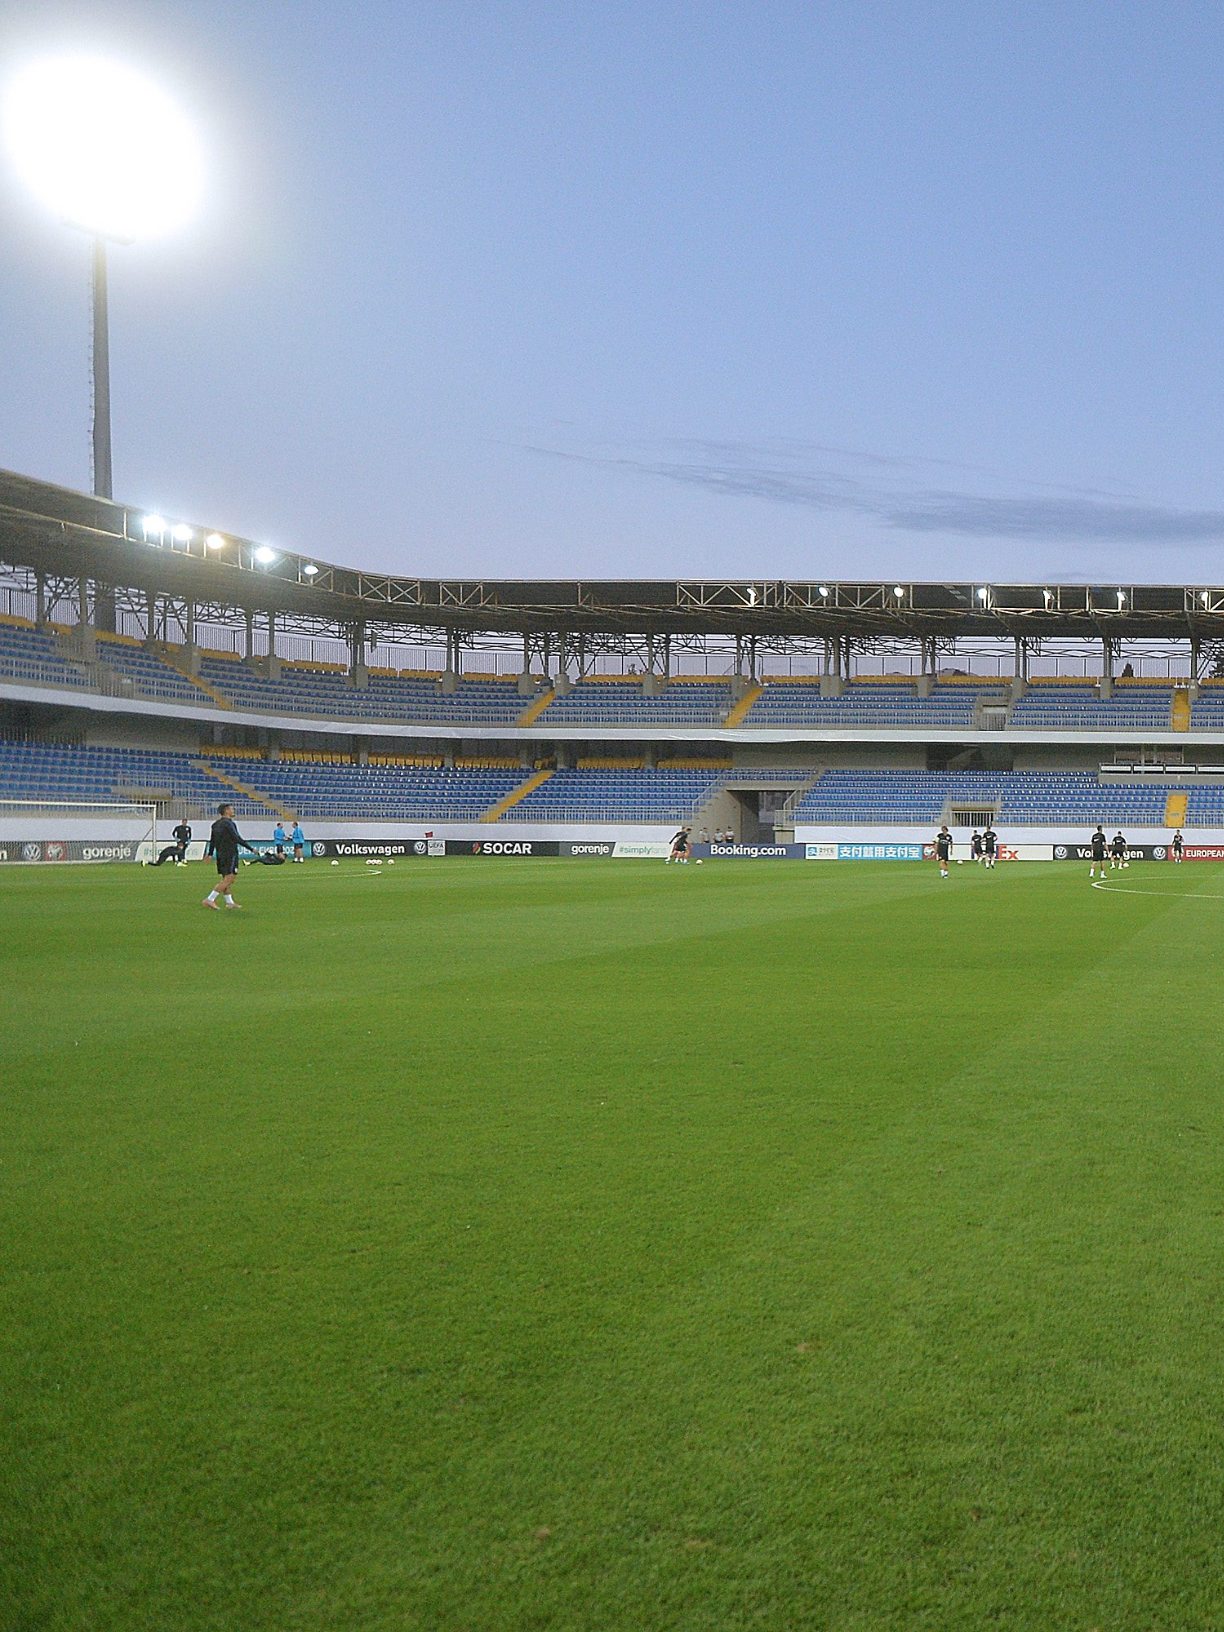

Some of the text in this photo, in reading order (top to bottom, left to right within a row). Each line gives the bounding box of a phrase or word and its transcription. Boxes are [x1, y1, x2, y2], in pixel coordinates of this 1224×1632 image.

[83, 845, 131, 860] gorenje
[335, 844, 405, 856] Volkswagen
[482, 842, 532, 855] SOCAR
[571, 844, 610, 856] gorenje
[710, 844, 787, 858] Booking.com
